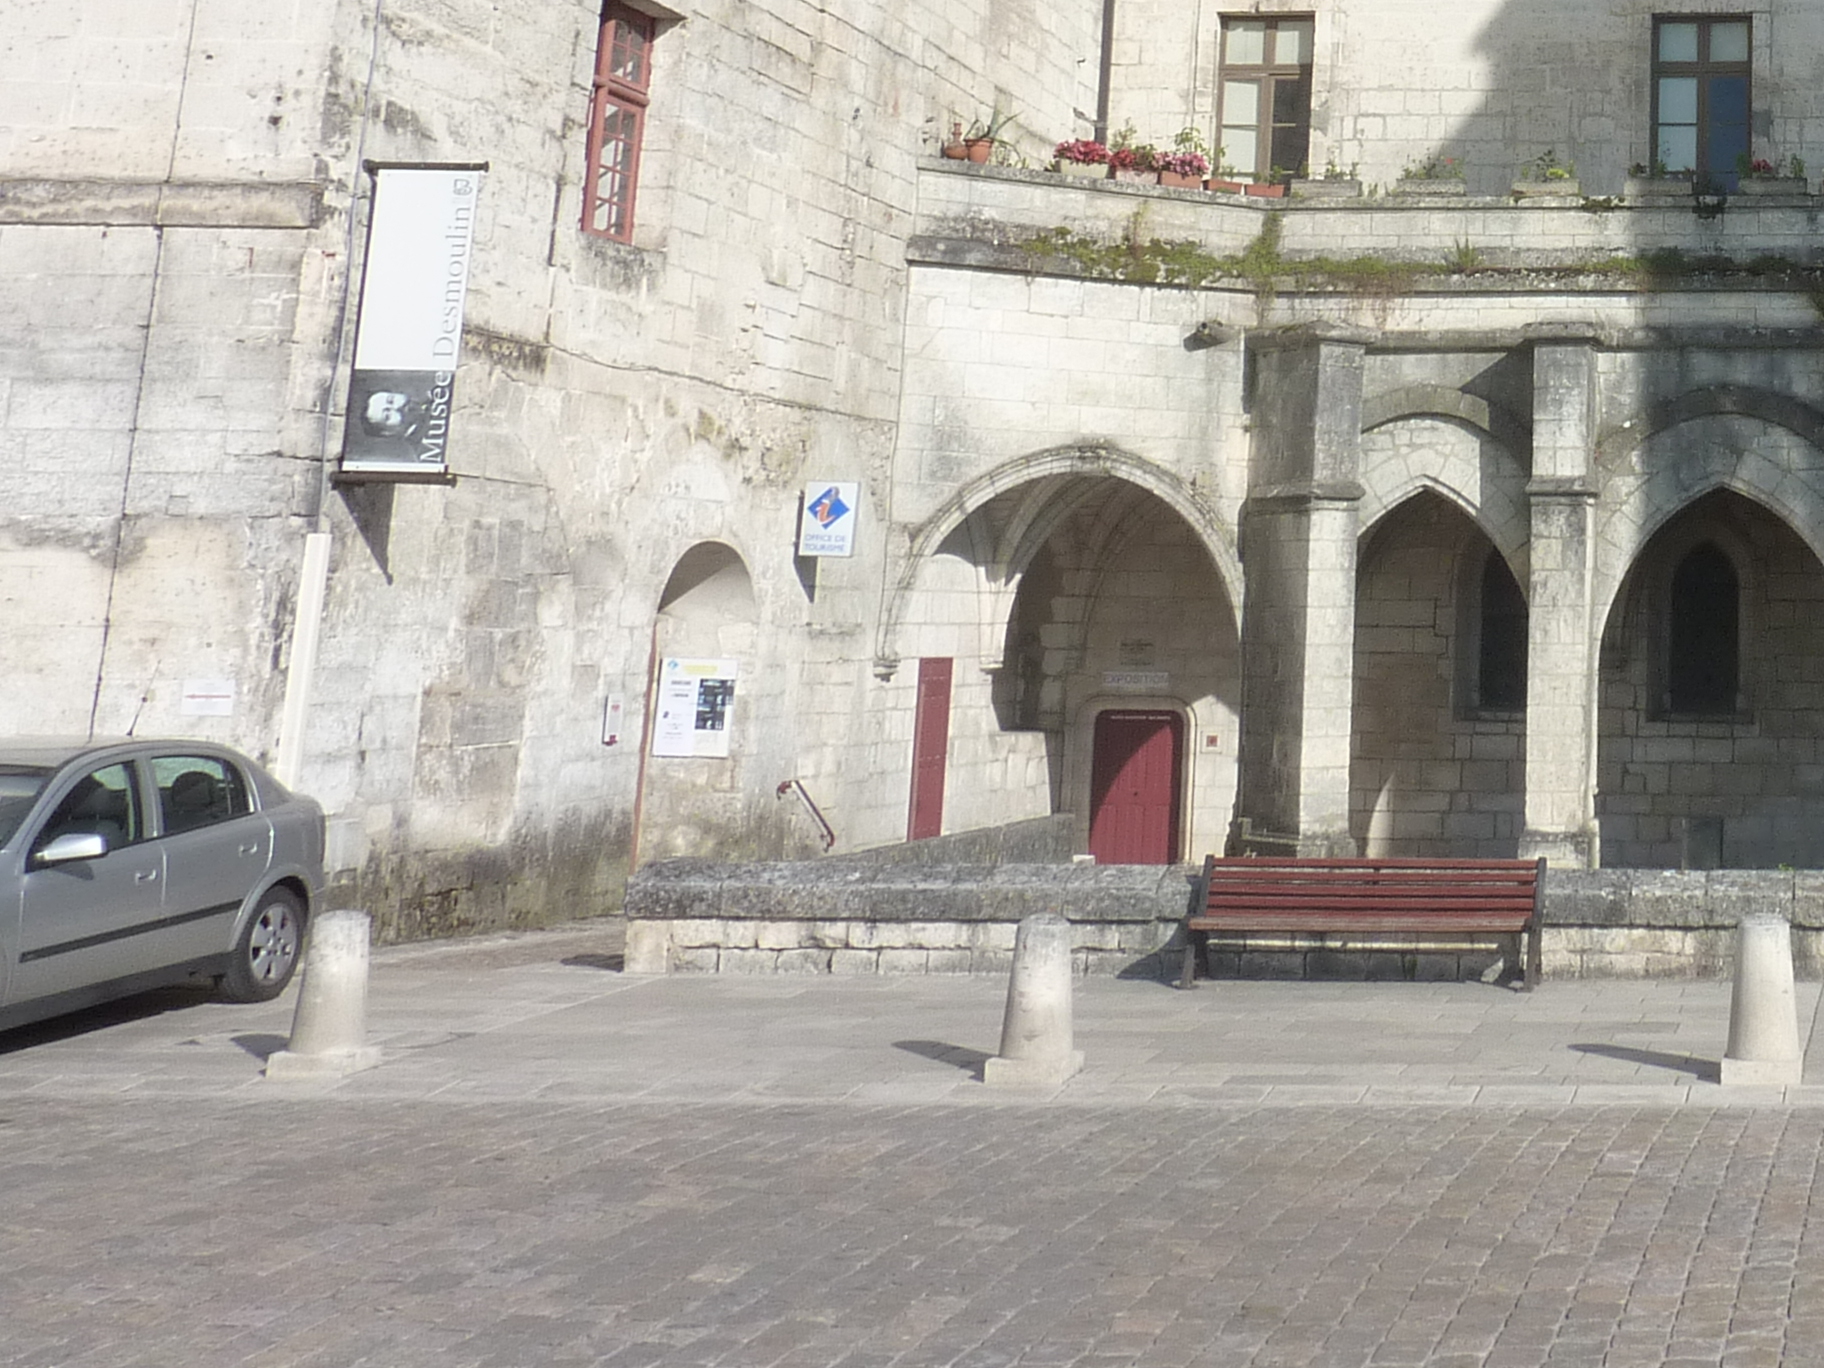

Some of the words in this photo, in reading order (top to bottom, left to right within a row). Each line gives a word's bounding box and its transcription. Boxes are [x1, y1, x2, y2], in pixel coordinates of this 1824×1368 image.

[433, 207, 471, 358] Desmoulin
[420, 370, 452, 462] Musée
[805, 534, 832, 542] OFFICE
[835, 535, 845, 543] DE
[804, 543, 845, 552] TOURISME
[1103, 673, 1169, 684] EXPOSITION
